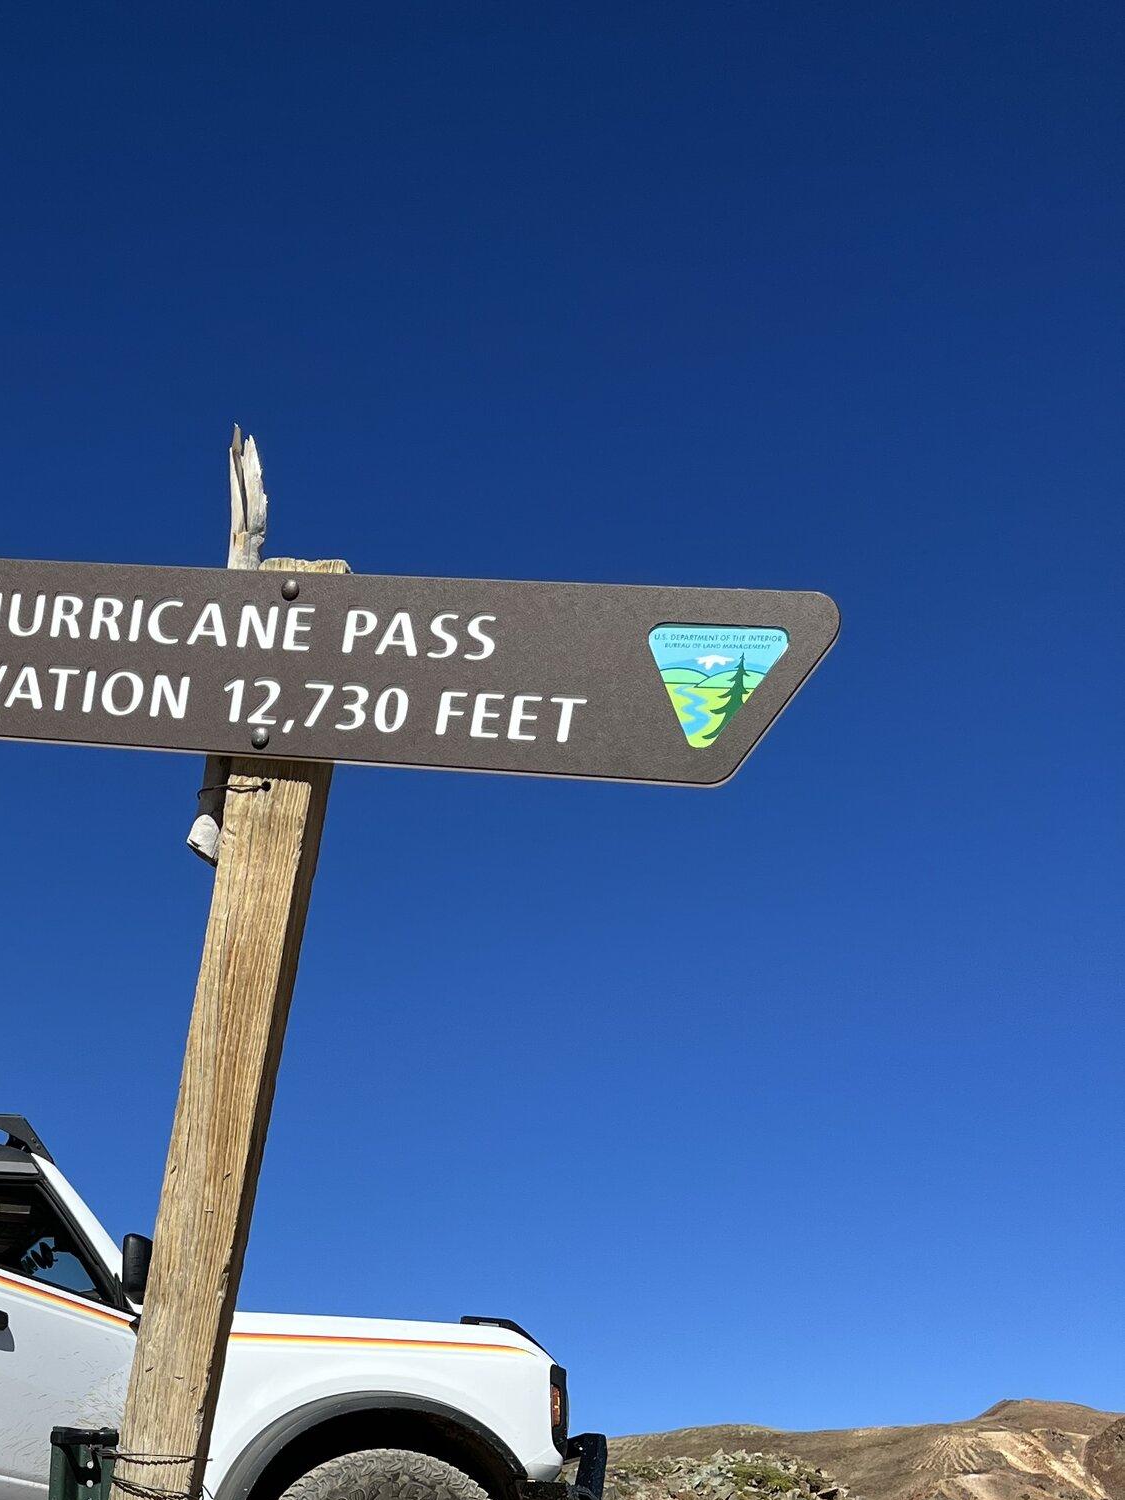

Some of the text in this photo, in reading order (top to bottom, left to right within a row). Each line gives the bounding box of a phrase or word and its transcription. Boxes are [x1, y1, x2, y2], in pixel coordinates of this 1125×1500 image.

[341, 609, 497, 661] PASS
[223, 679, 410, 735] 12,730
[434, 691, 588, 743] FEET
